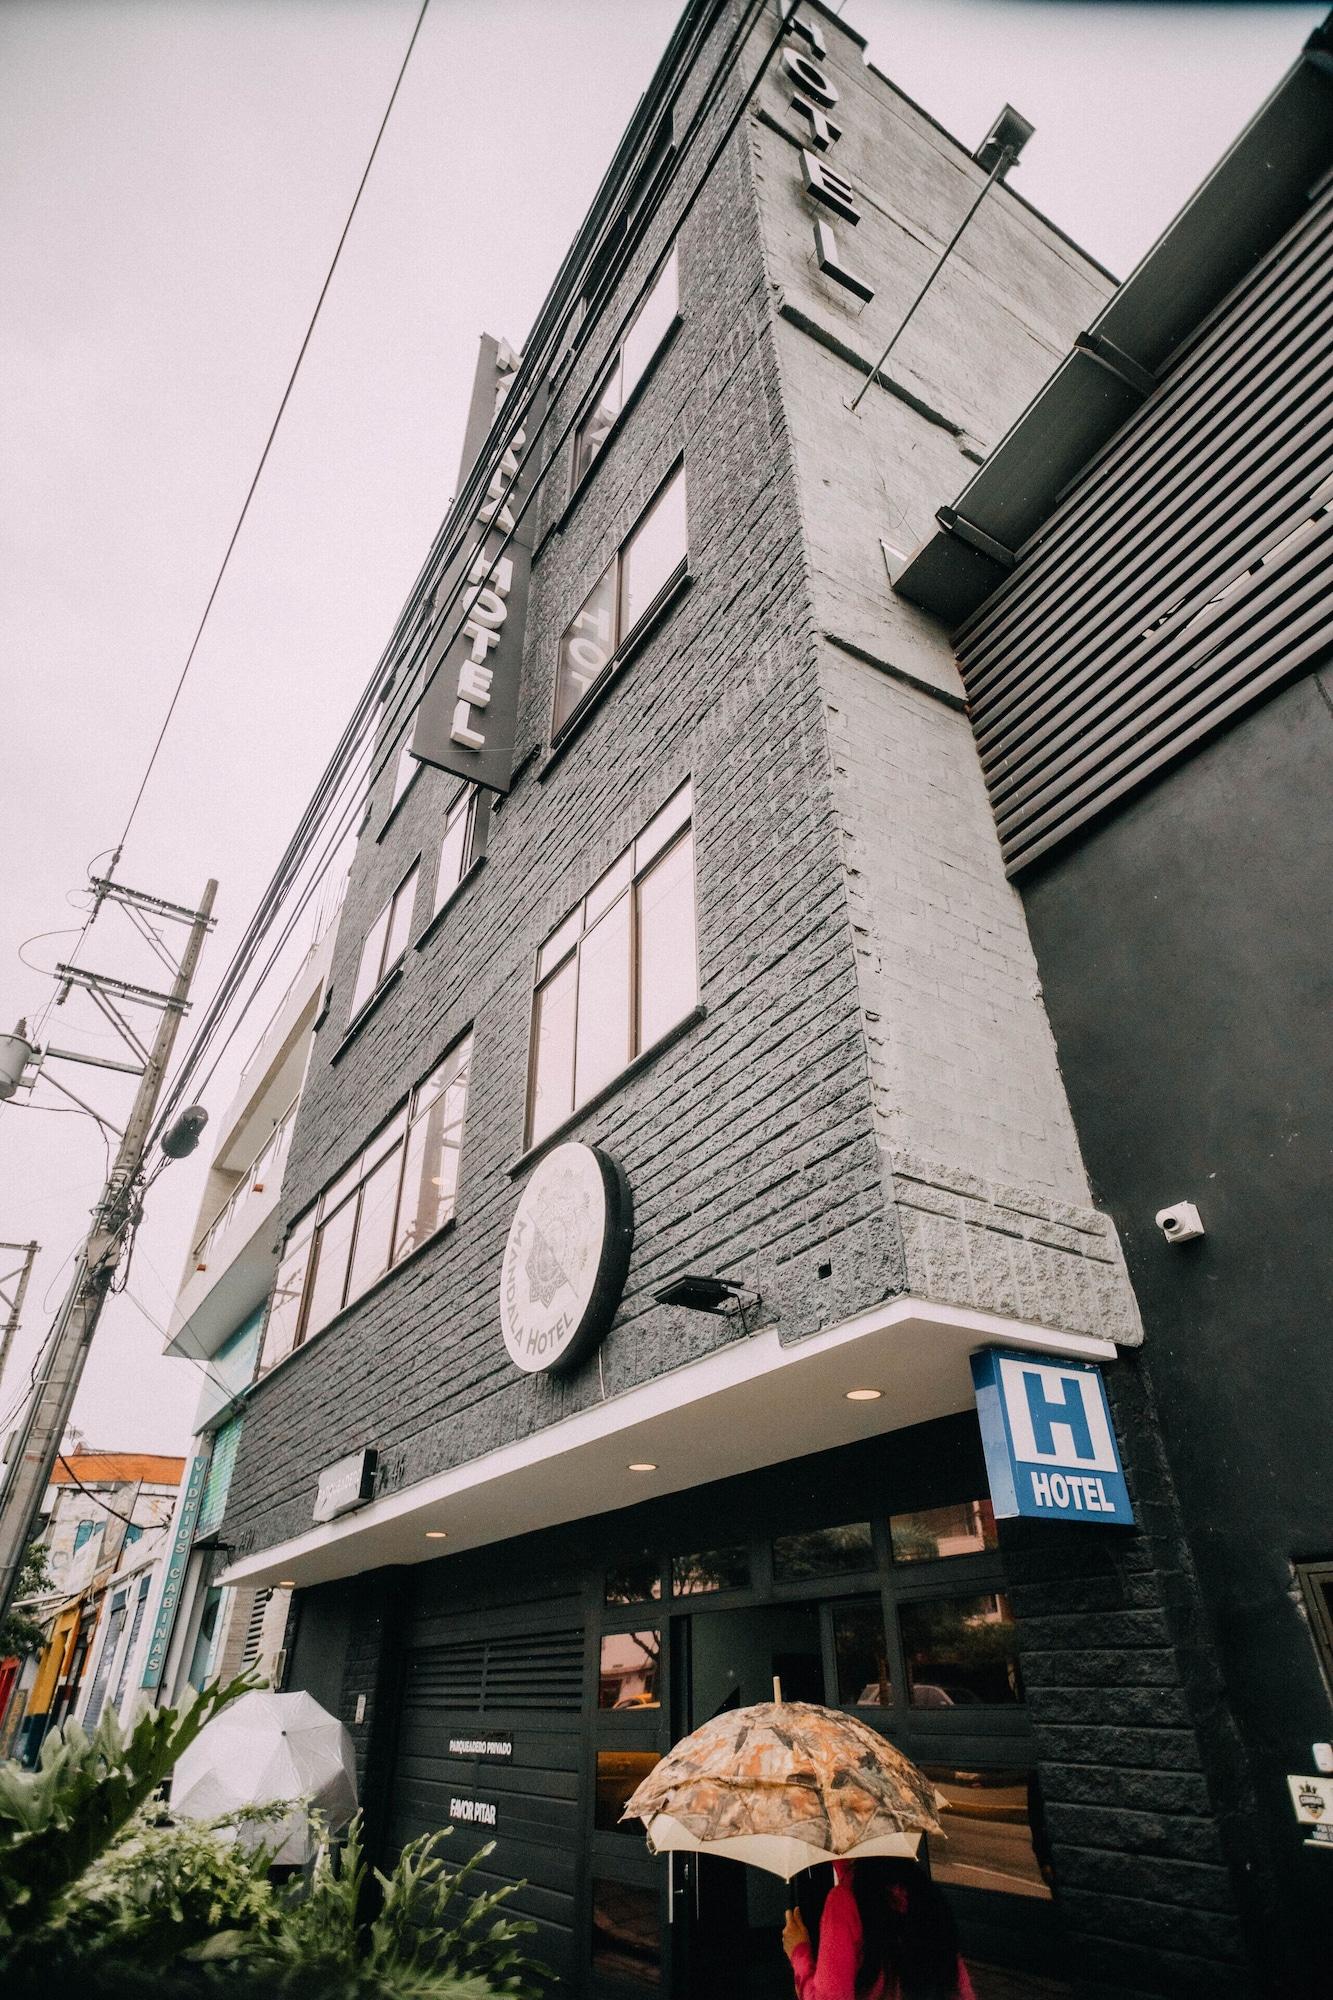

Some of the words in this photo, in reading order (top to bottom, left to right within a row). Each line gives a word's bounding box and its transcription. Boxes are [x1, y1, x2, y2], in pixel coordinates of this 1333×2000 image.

[450, 542, 514, 750] HOTEL
[506, 1220, 528, 1347] MANDALA
[526, 1311, 574, 1356] HOTEL
[1022, 1371, 1096, 1460] H
[175, 1461, 205, 1554] VIDRIOS
[1030, 1471, 1116, 1513] HOTEL
[148, 1567, 181, 1671] CABINAS
[449, 1740, 486, 1754] PARQUEADERO
[487, 1742, 512, 1755] PRIVADO
[449, 1798, 474, 1821] FAVOR
[473, 1801, 497, 1826] PITAR
